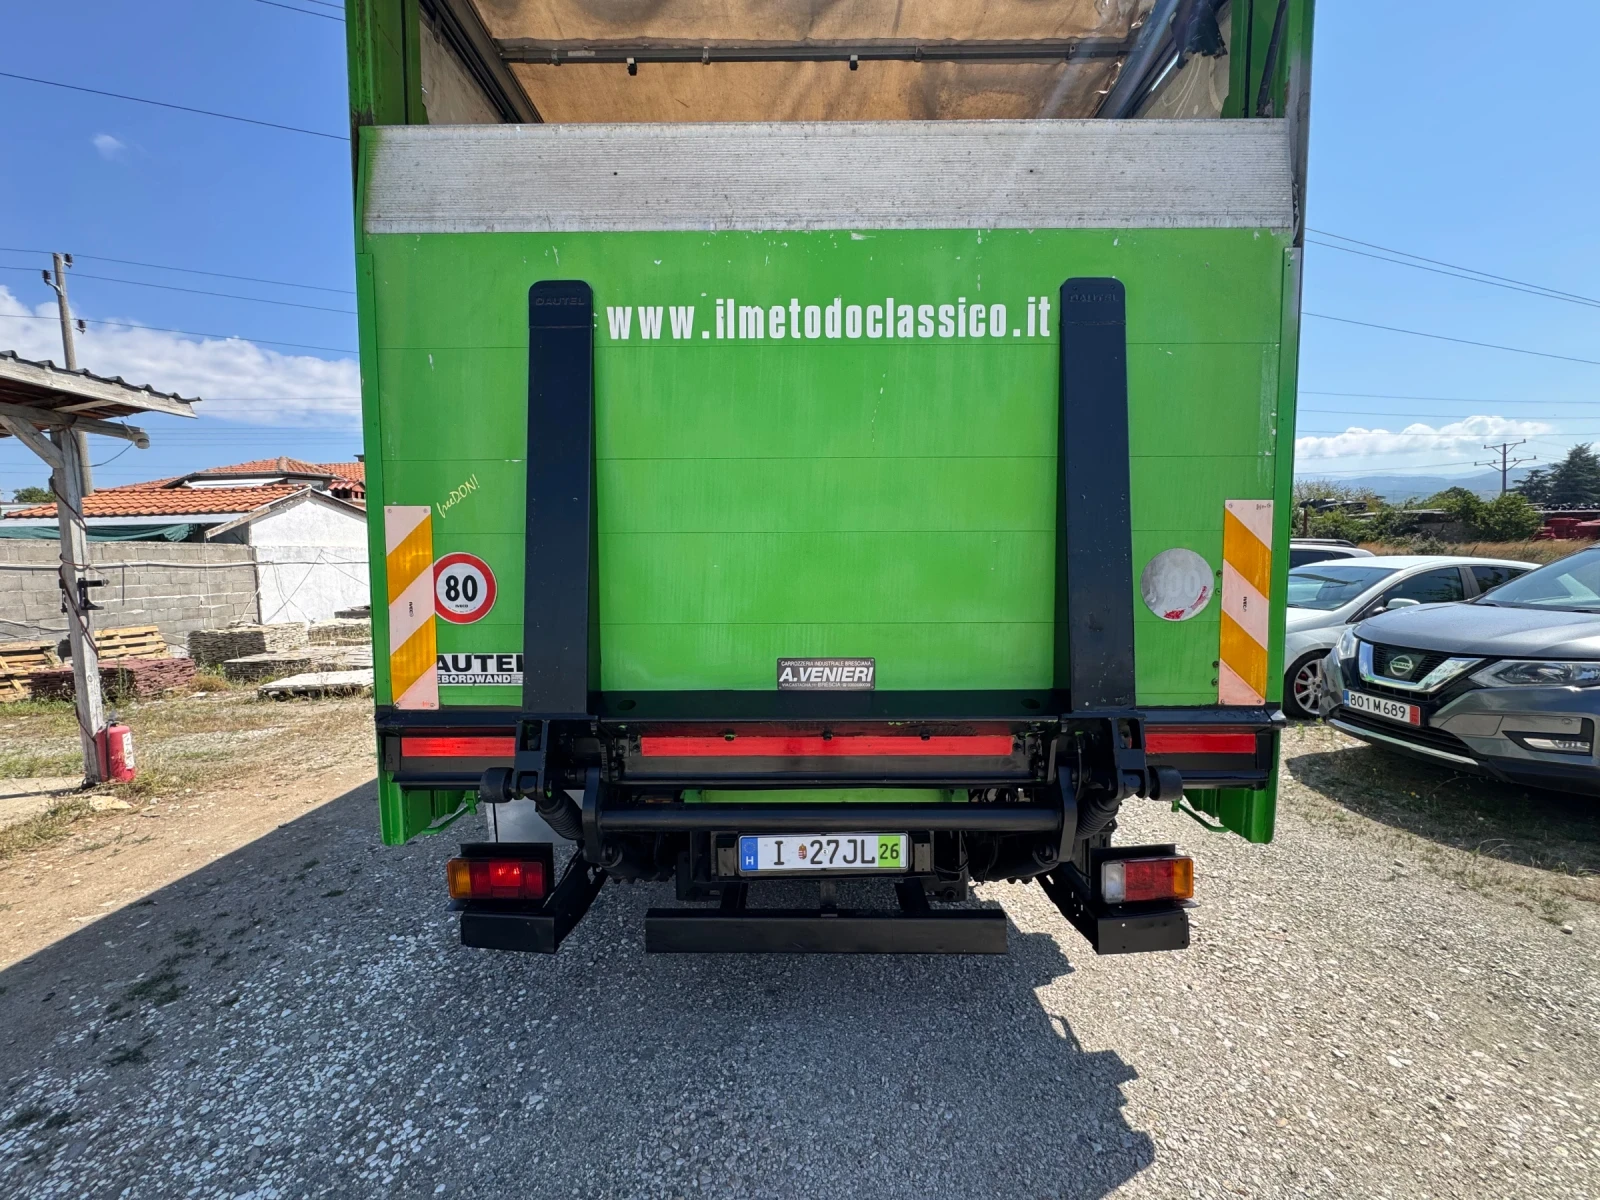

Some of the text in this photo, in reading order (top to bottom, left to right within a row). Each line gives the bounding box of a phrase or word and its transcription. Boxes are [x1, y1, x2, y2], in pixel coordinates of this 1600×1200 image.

[606, 296, 1051, 339] www.ilmetodoclassico.it
[445, 575, 478, 602] 80
[779, 667, 874, 682] A.VENIERI
[745, 856, 754, 866] H
[773, 839, 876, 866] I 27JL
[879, 843, 899, 860] 26
